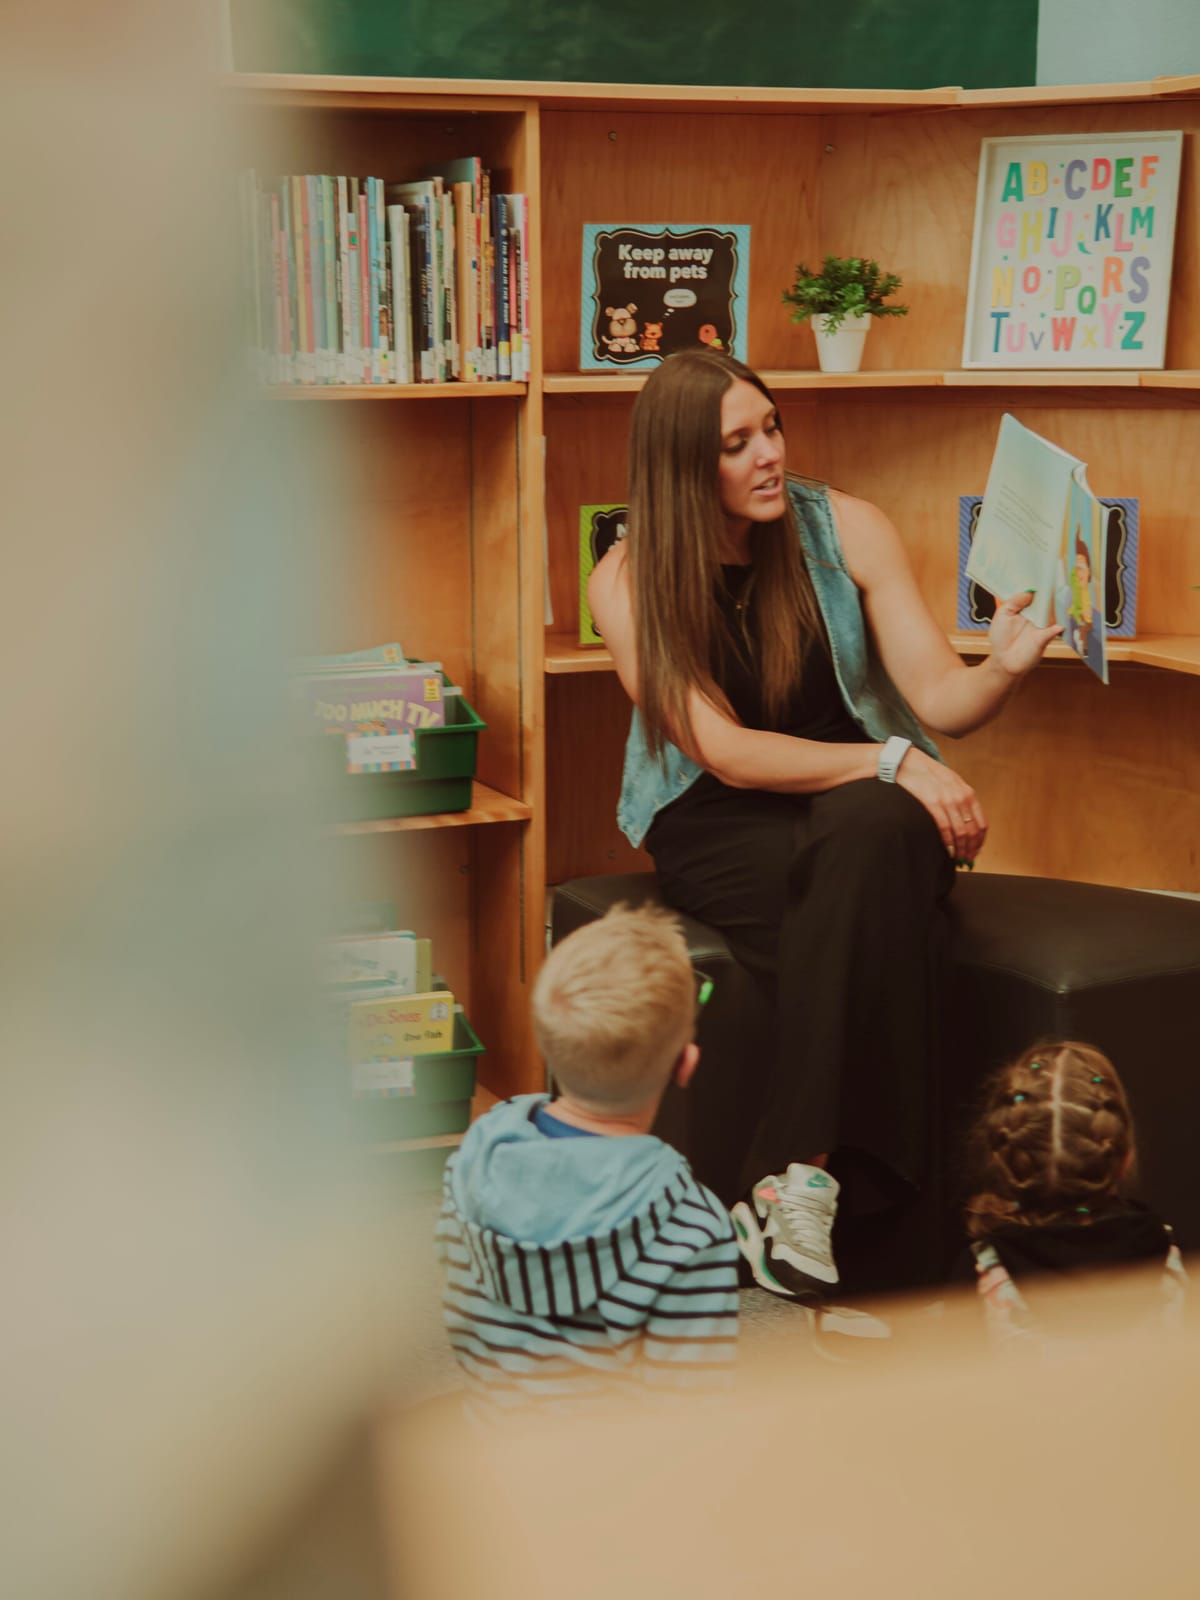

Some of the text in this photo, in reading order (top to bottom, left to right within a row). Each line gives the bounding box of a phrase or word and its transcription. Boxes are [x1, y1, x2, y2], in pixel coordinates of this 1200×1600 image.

[618, 244, 714, 264] Keep away
[623, 262, 708, 283] from pets
[314, 699, 441, 729] TOO MUCH TV
